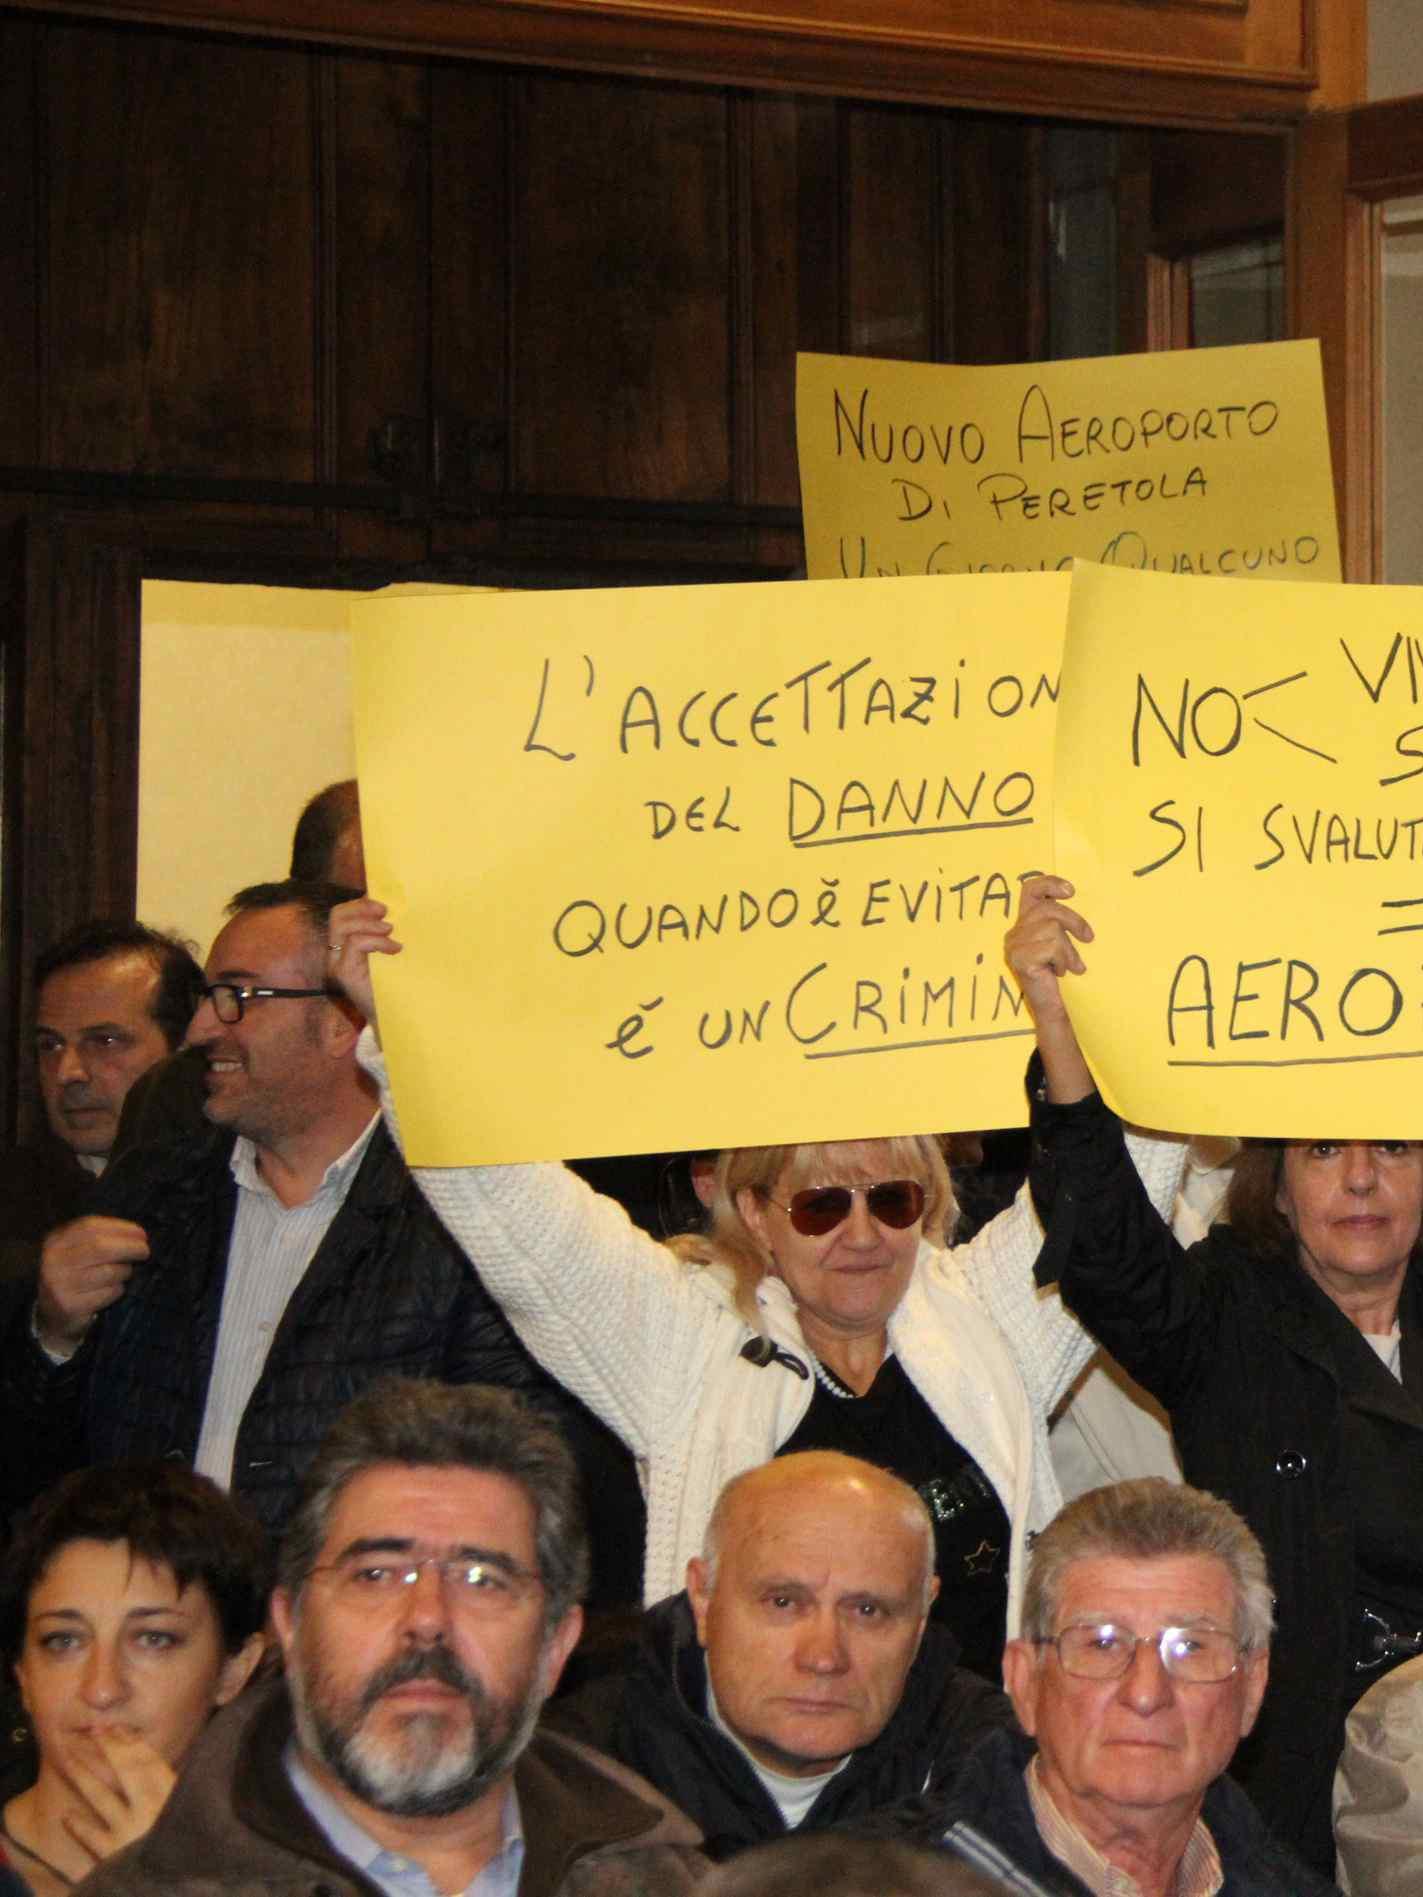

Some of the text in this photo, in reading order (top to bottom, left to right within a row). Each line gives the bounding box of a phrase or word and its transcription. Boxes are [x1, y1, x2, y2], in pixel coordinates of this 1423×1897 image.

[1017, 384, 1279, 464] AEROPORTO
[976, 466, 1208, 521] PERETOLA
[1131, 672, 1244, 768] NO
[643, 770, 1035, 842] DEL DANNO
[1131, 799, 1204, 878] SI
[551, 887, 800, 958] QUANDO
[697, 999, 772, 1050] UN
